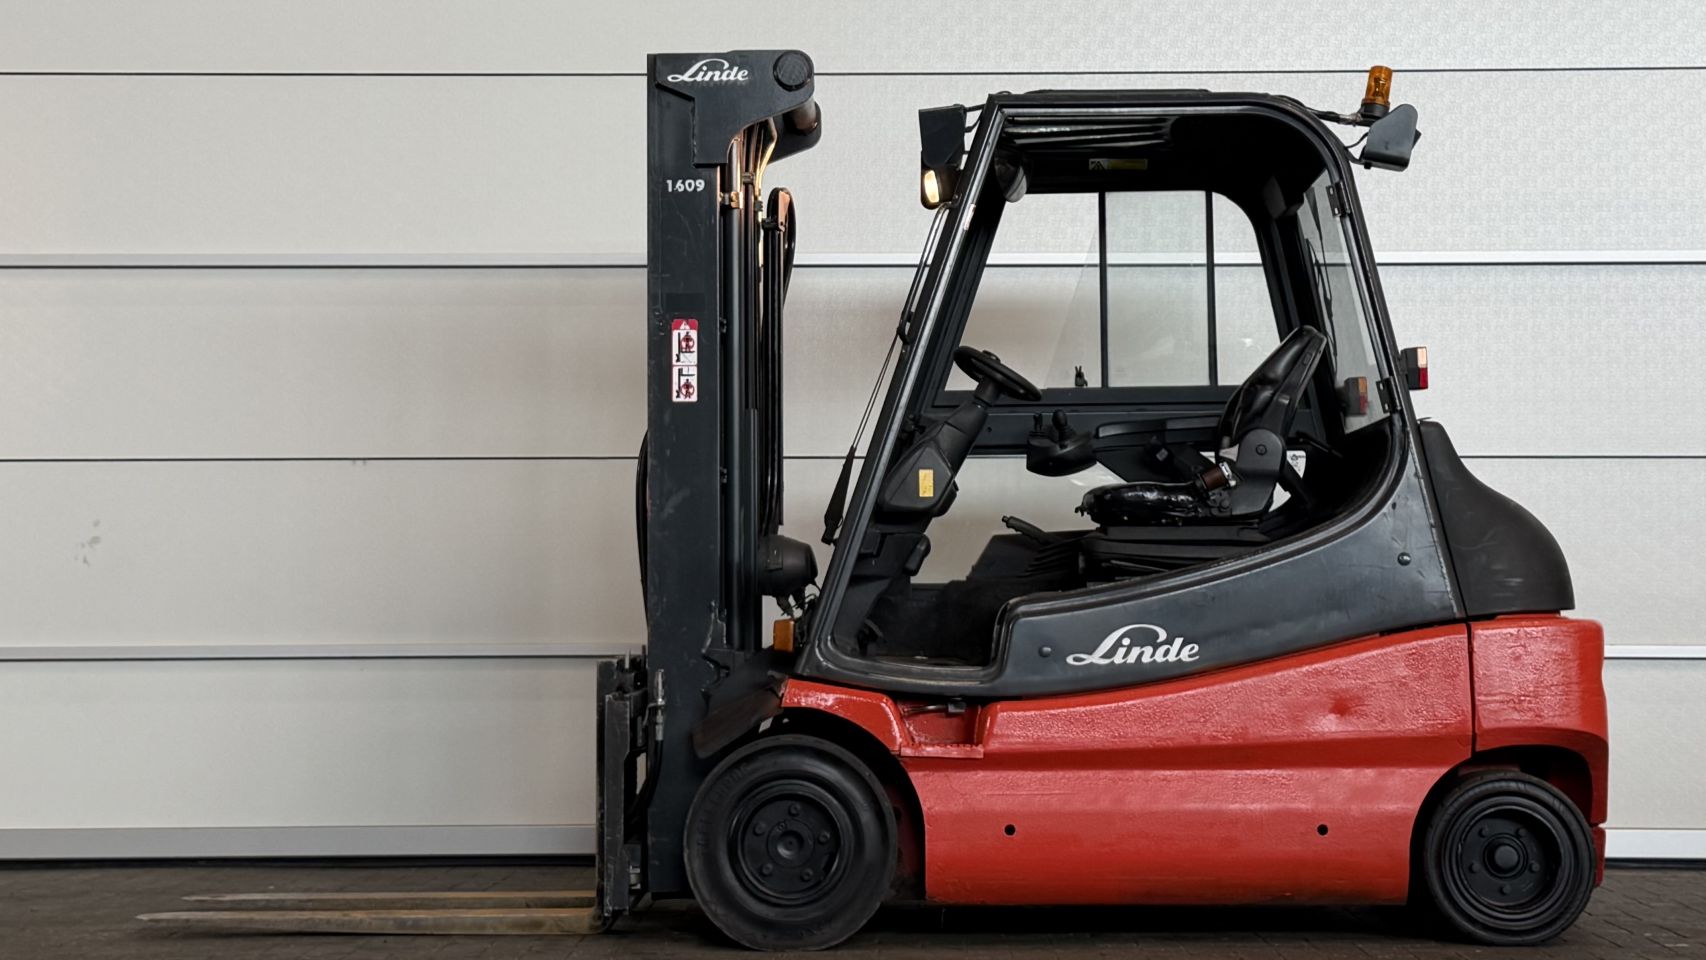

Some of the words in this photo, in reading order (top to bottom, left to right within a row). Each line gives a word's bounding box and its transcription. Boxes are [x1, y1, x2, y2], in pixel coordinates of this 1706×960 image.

[667, 58, 749, 82] Linde
[666, 179, 706, 193] 1609
[1066, 623, 1200, 666] Linde
